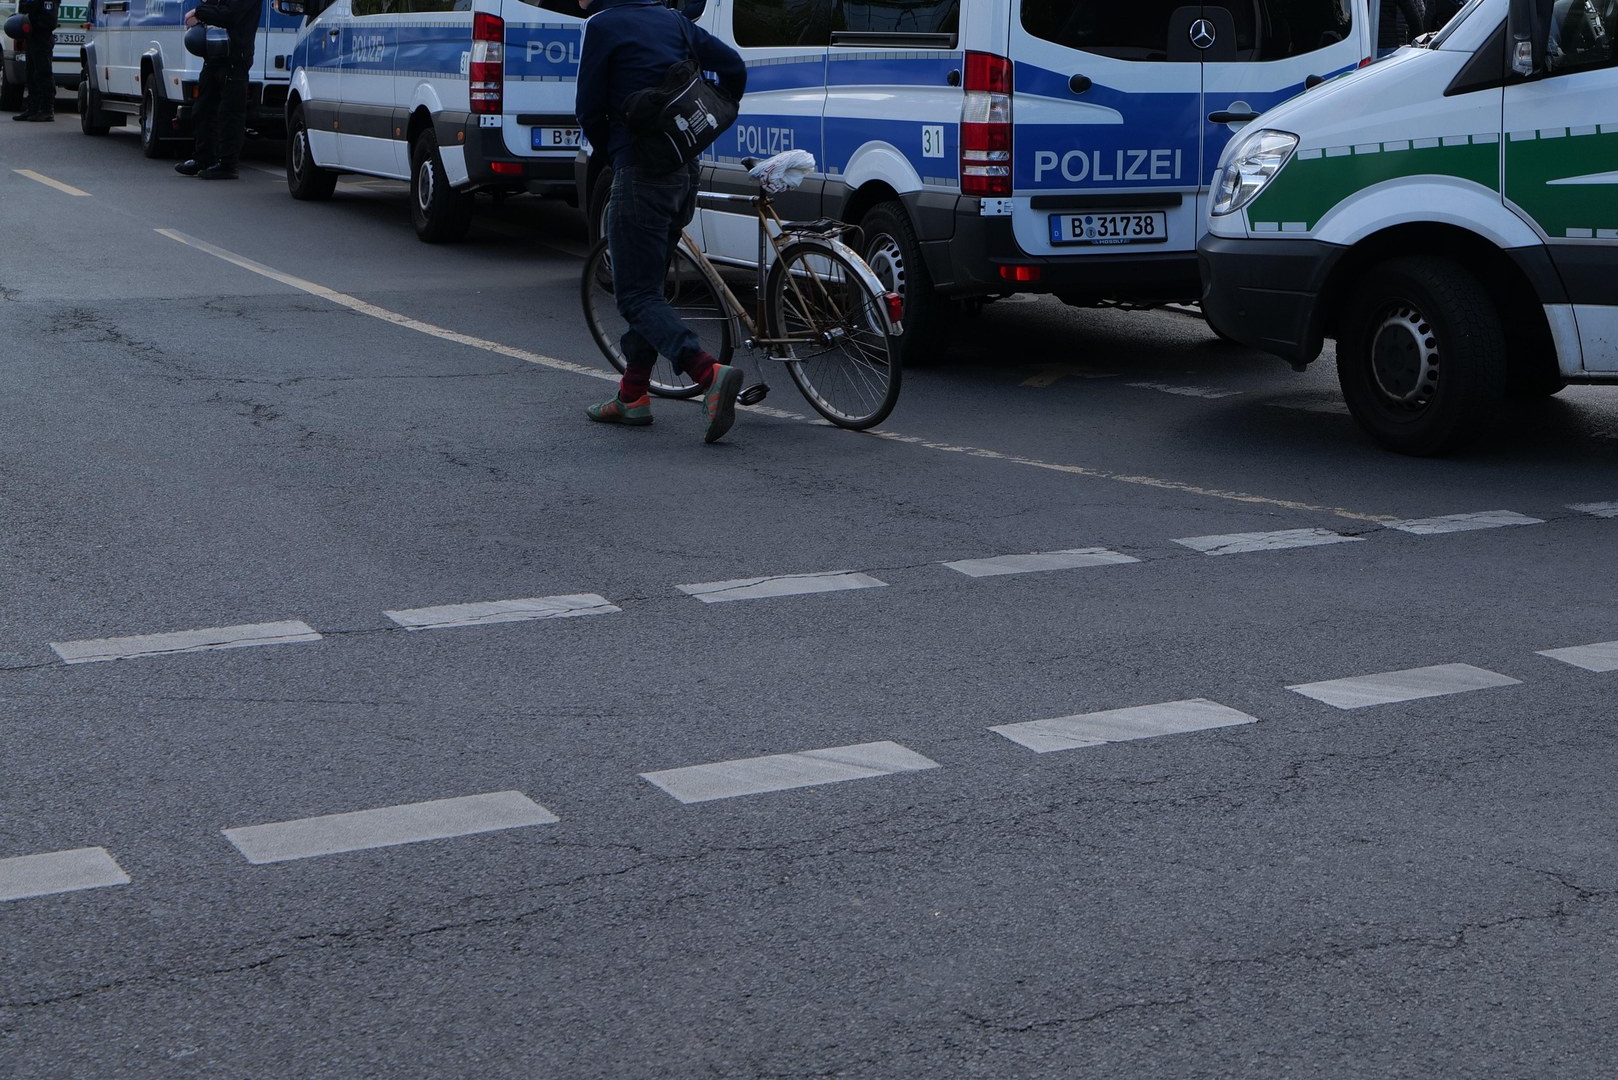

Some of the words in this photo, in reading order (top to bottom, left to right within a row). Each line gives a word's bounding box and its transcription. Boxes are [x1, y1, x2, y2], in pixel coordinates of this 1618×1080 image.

[58, 6, 87, 18] LIZ
[351, 35, 385, 62] POLIZEI
[526, 40, 581, 64] POL
[553, 130, 562, 145] B
[572, 130, 581, 145] 7
[737, 125, 794, 157] POLIZEI
[923, 129, 940, 154] 31
[1034, 149, 1182, 182] POLIZEI
[1071, 217, 1084, 238] B
[1097, 215, 1155, 236] 31738
